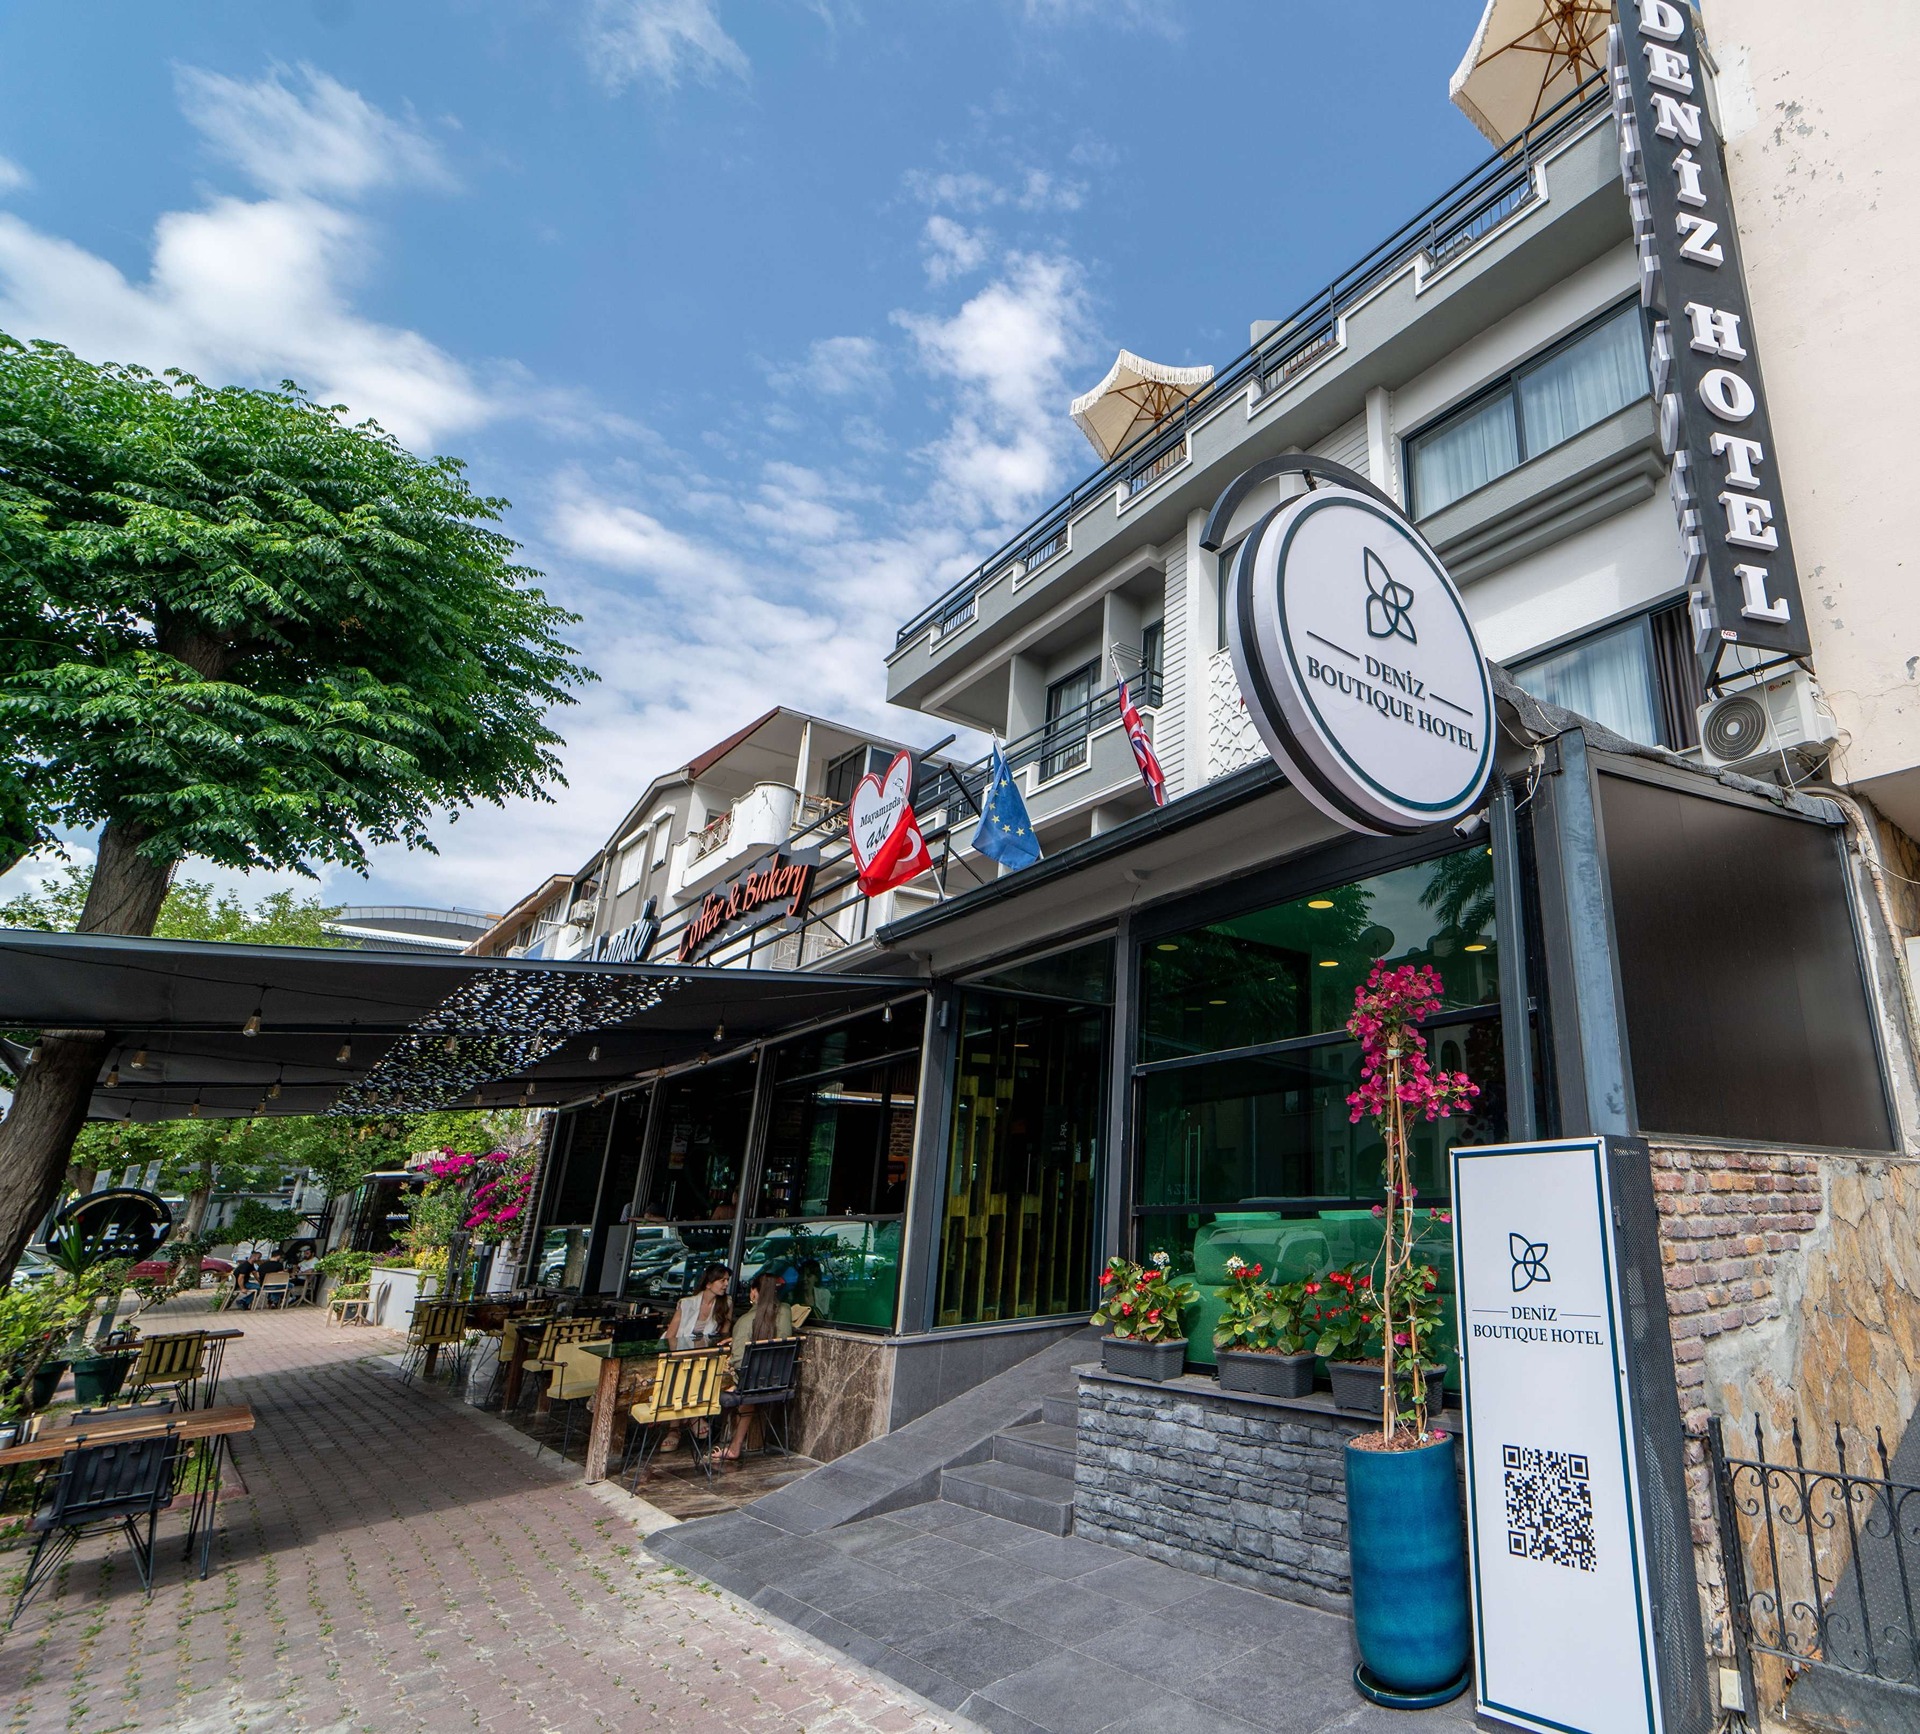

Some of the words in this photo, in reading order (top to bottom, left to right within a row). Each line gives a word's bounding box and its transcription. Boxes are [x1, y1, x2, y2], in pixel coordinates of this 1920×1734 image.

[1633, 0, 1724, 268] DENİZ
[1684, 301, 1791, 625] HOTEL
[1306, 655, 1414, 724] BOUTIQUE
[1417, 709, 1478, 752] HOTEL
[1364, 654, 1426, 700] DENİZ
[678, 893, 725, 961] Coffee
[725, 882, 740, 920] &
[742, 853, 808, 916] Bakery
[1473, 1324, 1548, 1344] BOUTIQUE
[1551, 1329, 1604, 1346] HOTEL
[1511, 1304, 1558, 1322] DENİZ
